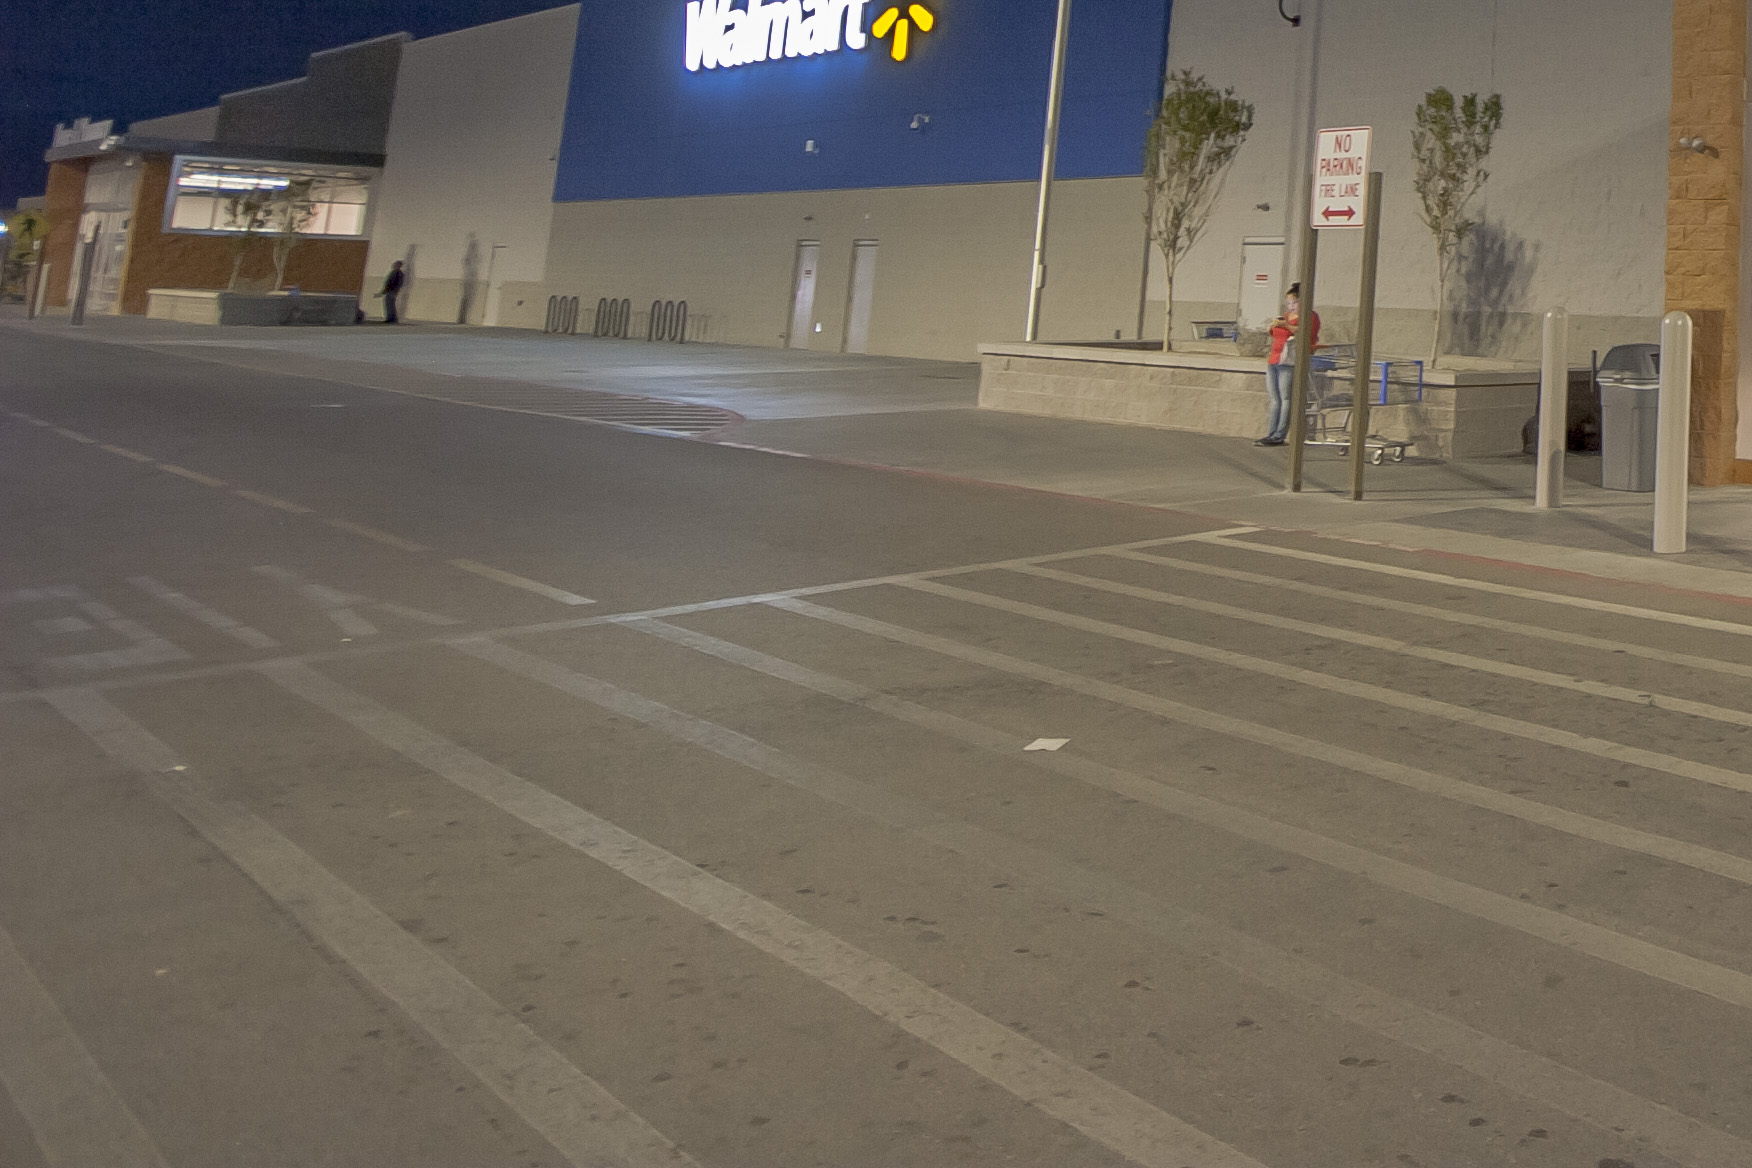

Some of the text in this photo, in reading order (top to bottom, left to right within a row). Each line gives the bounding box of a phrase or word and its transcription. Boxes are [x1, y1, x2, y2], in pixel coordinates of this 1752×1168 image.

[1333, 134, 1352, 153] NO
[1320, 157, 1363, 176] PARKING
[1320, 183, 1360, 198] FIRE LANE
